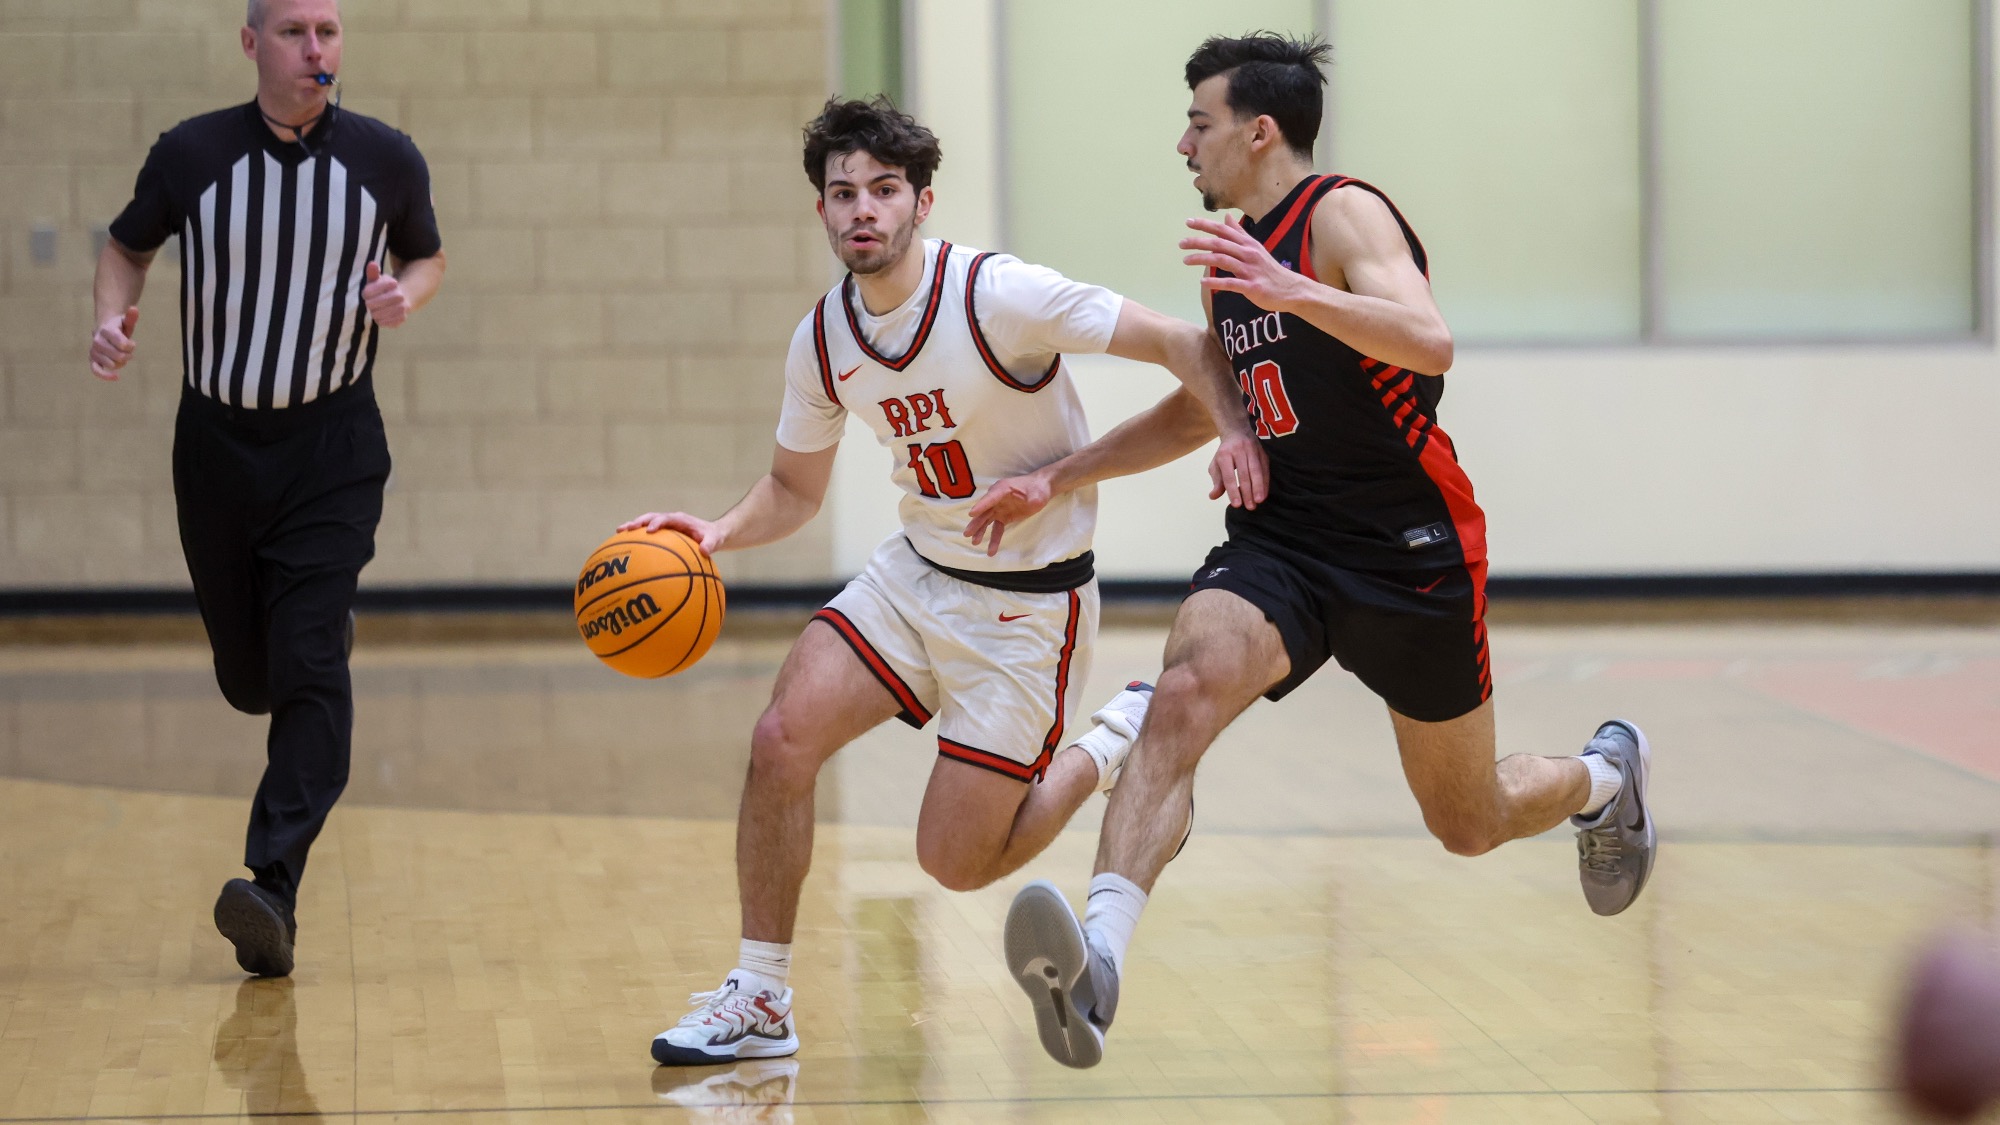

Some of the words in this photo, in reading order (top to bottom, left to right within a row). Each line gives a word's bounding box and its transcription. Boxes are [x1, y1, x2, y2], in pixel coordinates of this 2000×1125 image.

[1221, 310, 1288, 361] Bard
[877, 388, 958, 438] RPI
[1239, 359, 1300, 440] 10
[906, 439, 977, 500] 10
[1433, 528, 1441, 537] L
[578, 555, 630, 598] NCAA
[580, 592, 662, 641] Wilson
